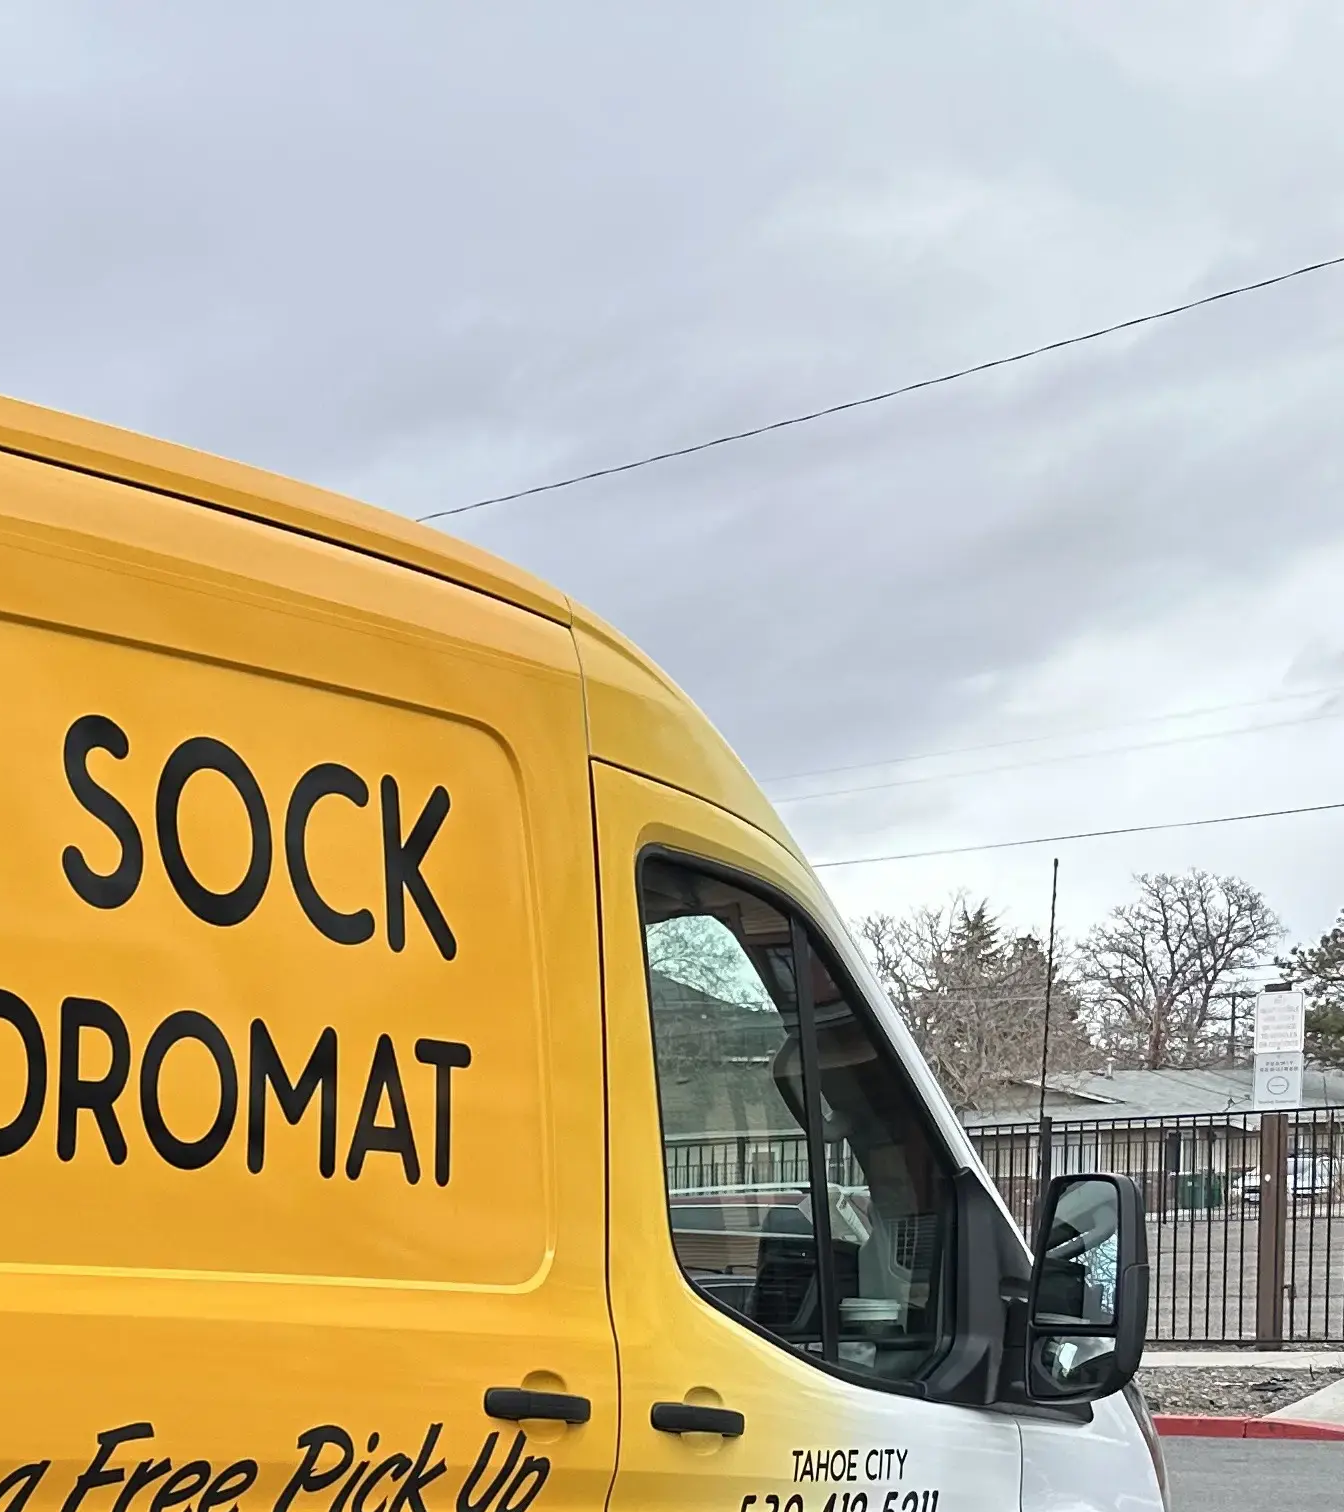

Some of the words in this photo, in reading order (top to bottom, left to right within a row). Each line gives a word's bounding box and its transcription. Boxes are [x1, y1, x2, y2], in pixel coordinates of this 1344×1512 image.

[62, 714, 457, 961] SOCK
[792, 1449, 859, 1483] TAHOE
[865, 1448, 909, 1481] CITY
